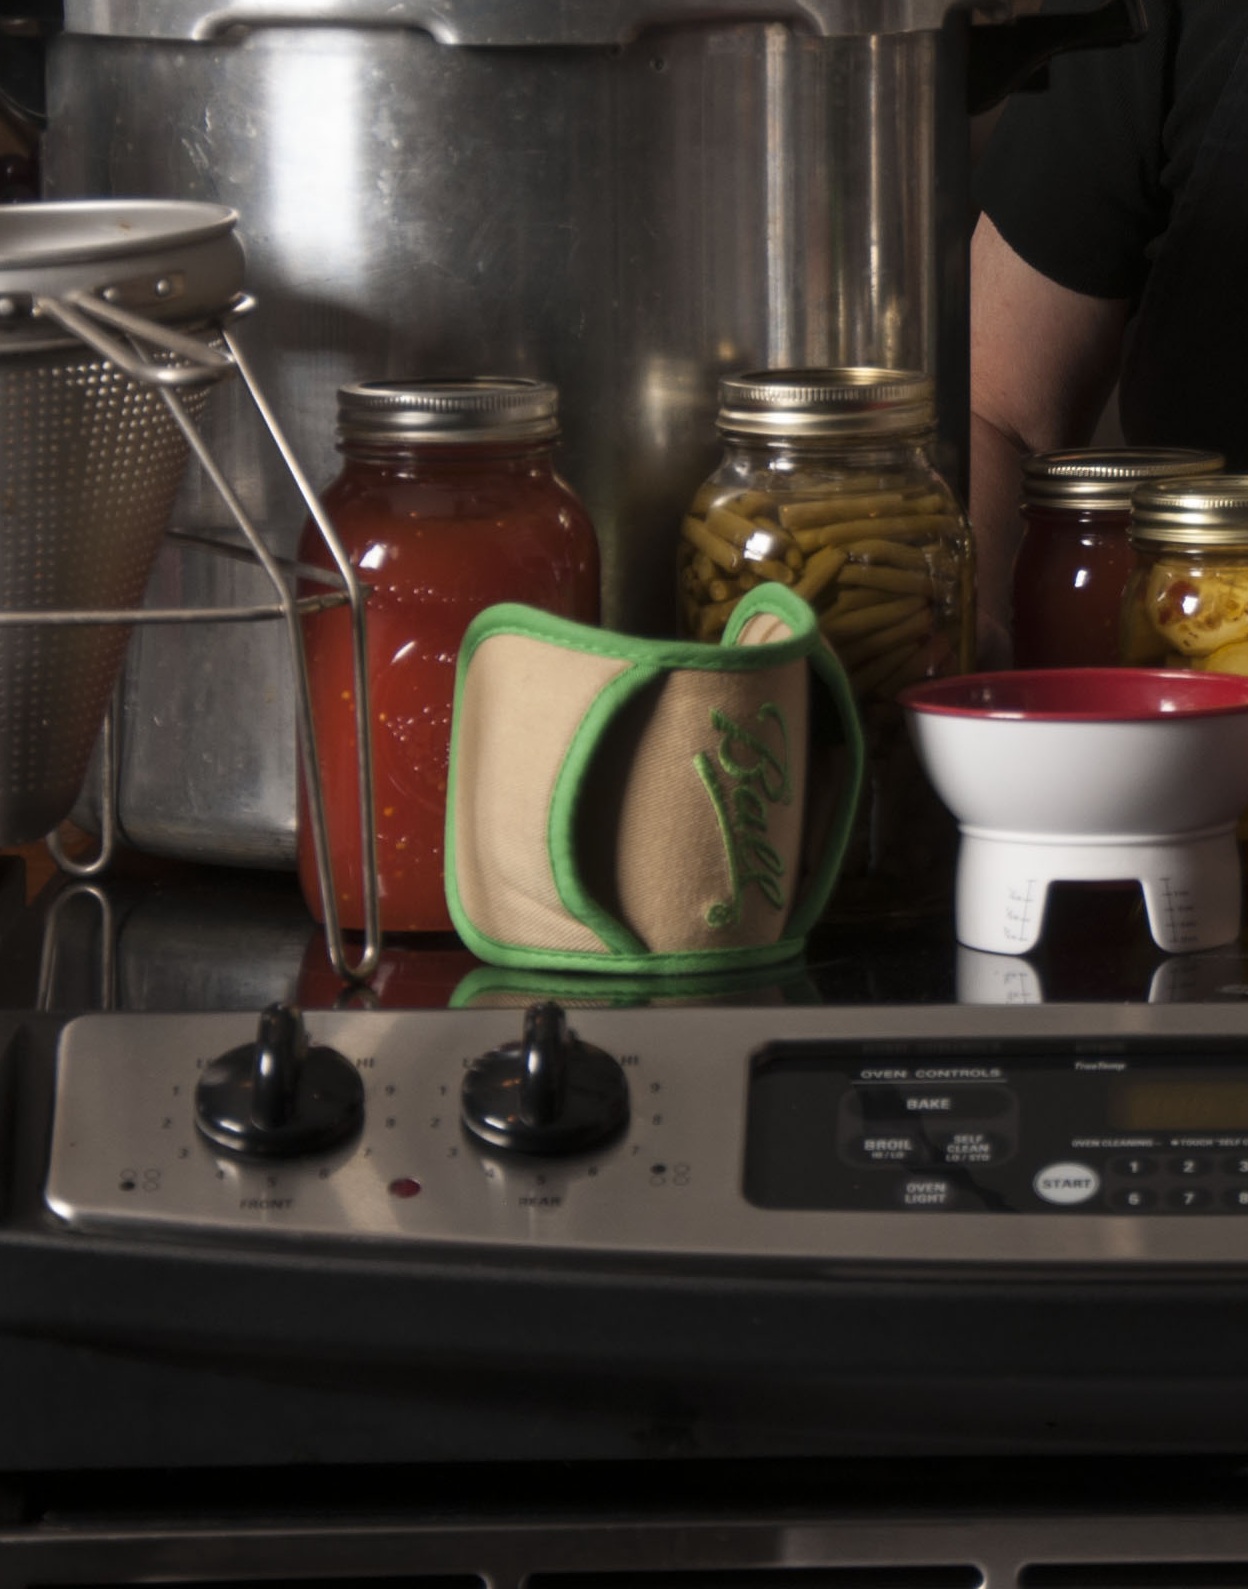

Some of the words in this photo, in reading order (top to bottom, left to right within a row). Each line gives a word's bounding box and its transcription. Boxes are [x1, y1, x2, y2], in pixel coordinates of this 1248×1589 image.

[692, 702, 790, 925] Ball
[859, 1068, 907, 1080] OVEN
[914, 1066, 1003, 1079] CONTROLS
[905, 1097, 952, 1111] BAKE
[863, 1137, 913, 1151] BROIL
[953, 1133, 983, 1143] SELF
[946, 1143, 991, 1153] CLEAN
[1129, 1160, 1139, 1173] 1
[1183, 1160, 1197, 1173] 2
[906, 1182, 947, 1193] OVEN
[1042, 1178, 1092, 1189] START
[239, 1198, 293, 1210] FRONT
[905, 1192, 947, 1204] LIGHT
[1128, 1191, 1140, 1205] 6
[1183, 1191, 1197, 1205] 7
